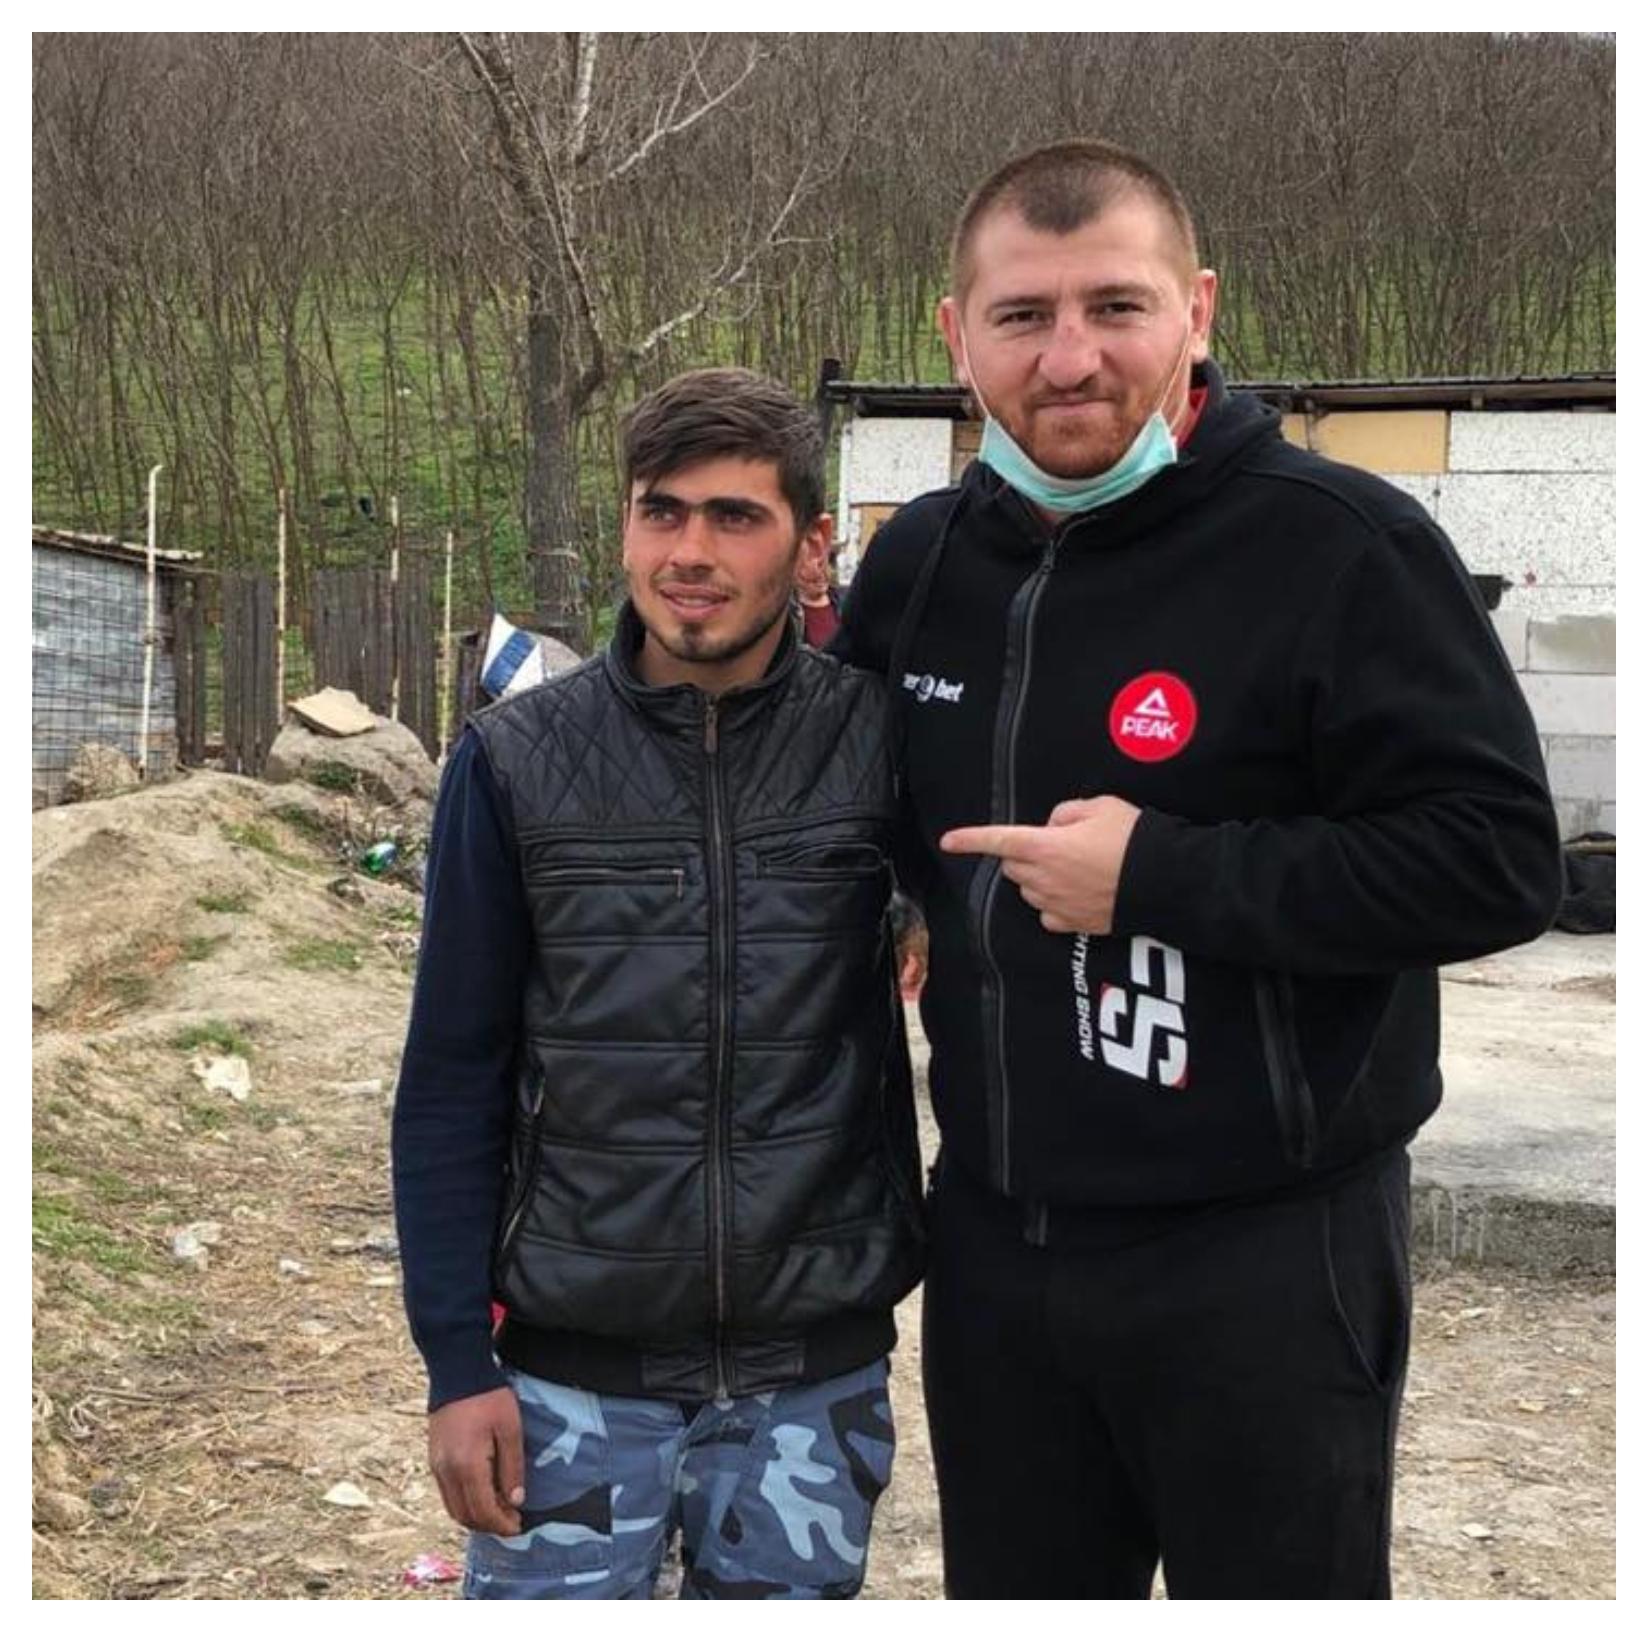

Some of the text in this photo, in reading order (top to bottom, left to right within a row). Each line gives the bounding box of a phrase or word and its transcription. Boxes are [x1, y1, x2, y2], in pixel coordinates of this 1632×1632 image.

[935, 678, 964, 702] bet
[1121, 716, 1179, 742] PEAK
[1076, 995, 1095, 1060] SHOW
